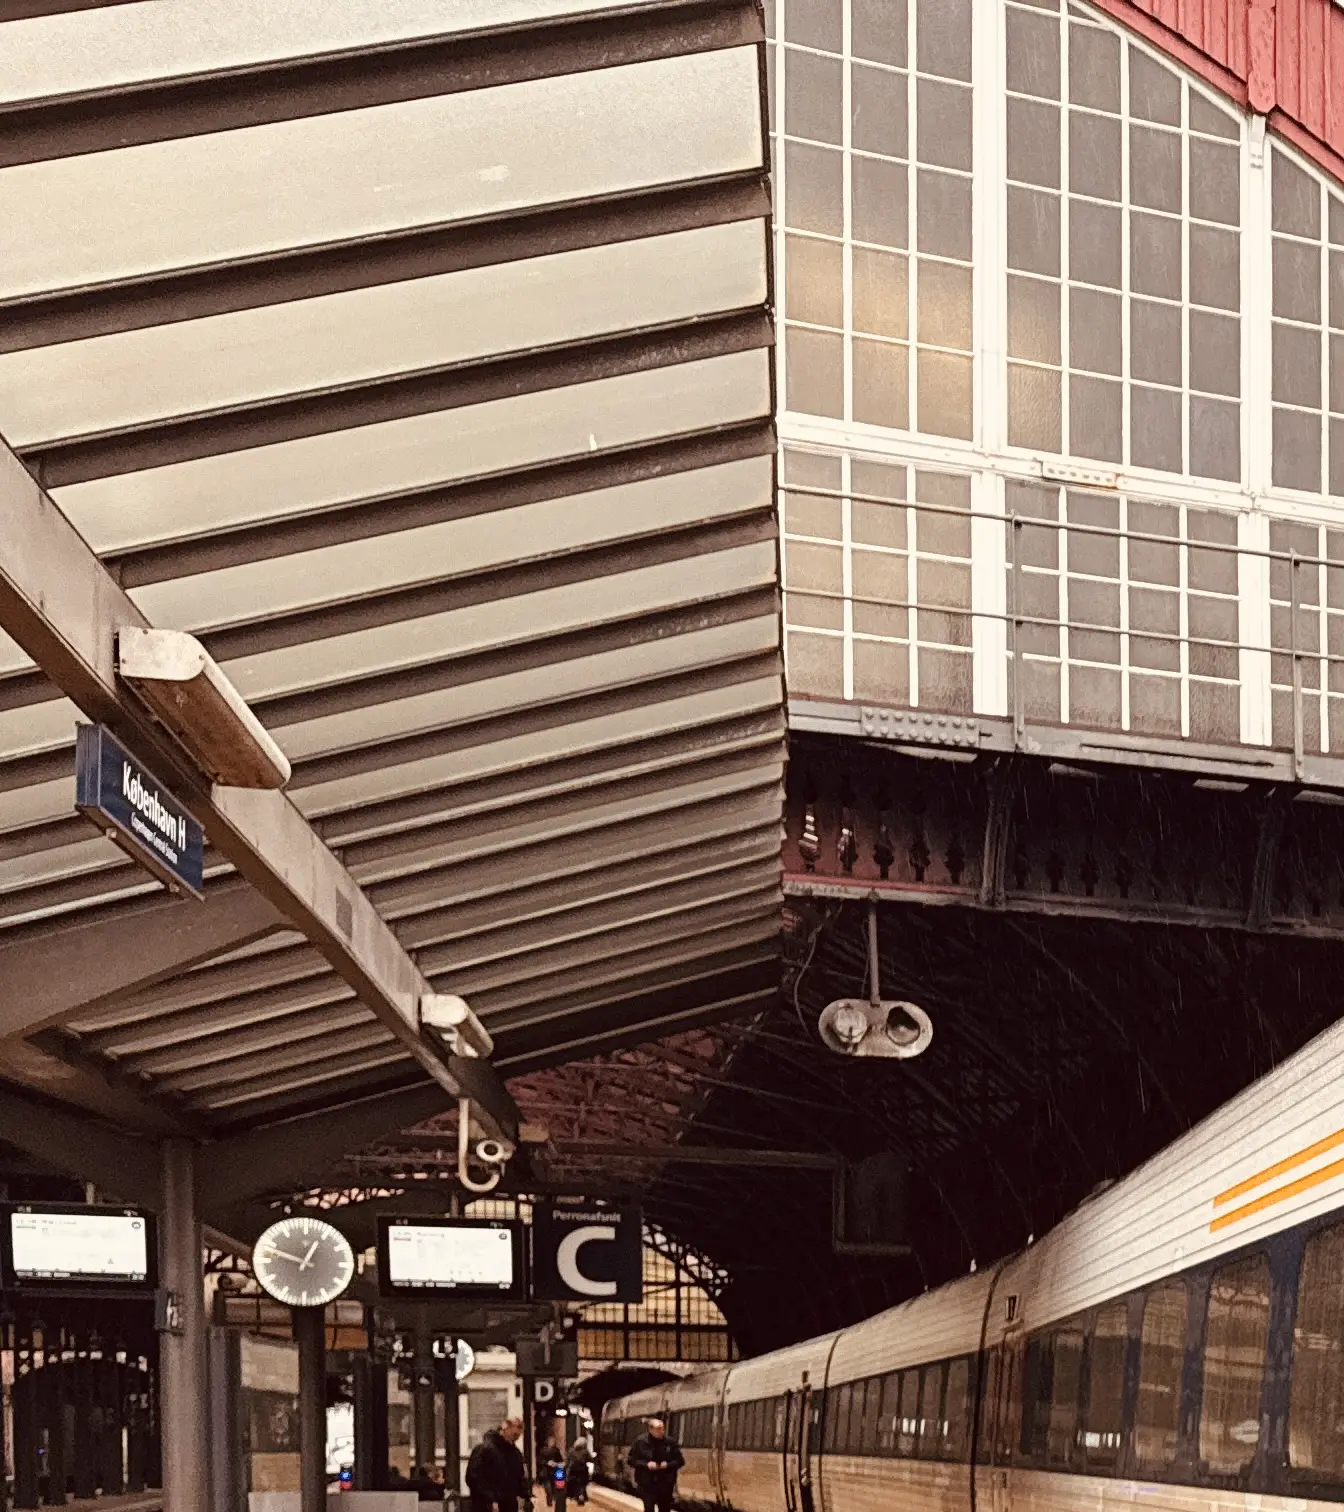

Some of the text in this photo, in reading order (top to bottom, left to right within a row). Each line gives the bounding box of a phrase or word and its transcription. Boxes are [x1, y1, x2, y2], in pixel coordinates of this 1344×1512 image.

[122, 760, 177, 843] København
[178, 815, 186, 852] H
[556, 1225, 617, 1297] C
[534, 1381, 555, 1403] D
